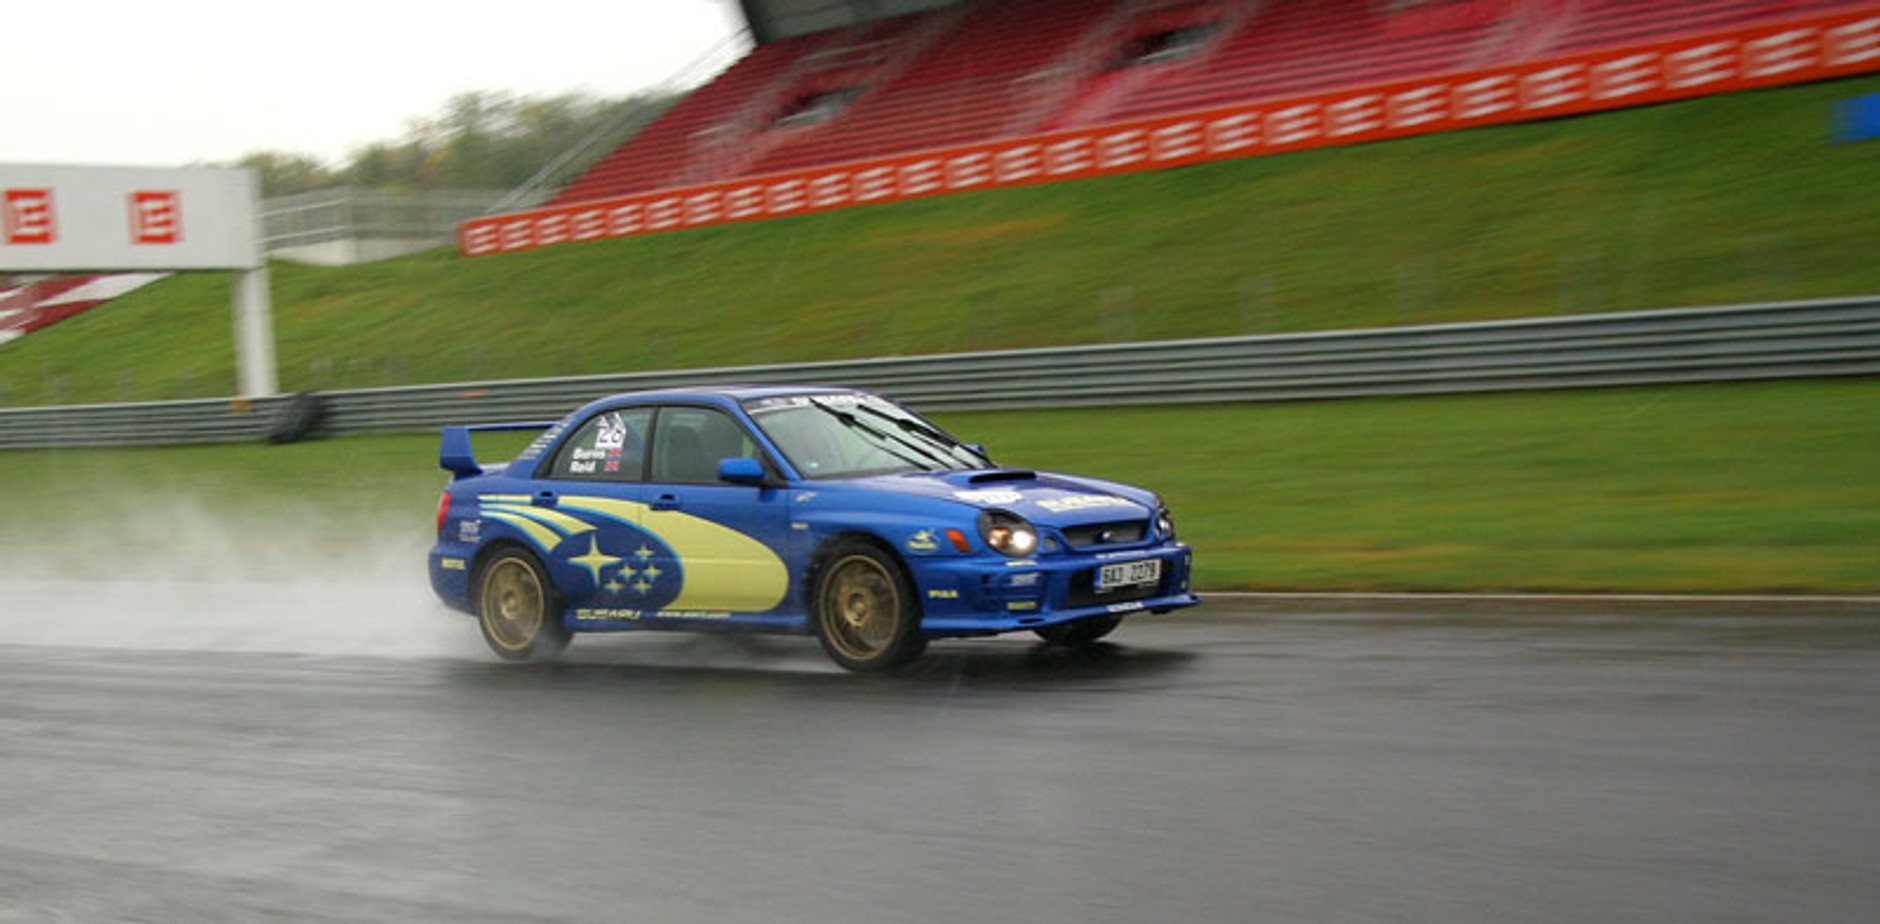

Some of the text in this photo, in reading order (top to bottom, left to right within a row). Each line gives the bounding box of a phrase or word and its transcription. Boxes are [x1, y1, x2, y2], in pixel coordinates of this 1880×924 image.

[573, 448, 605, 460] Burns
[569, 461, 596, 473] Reid
[576, 608, 642, 620] SUBARU
